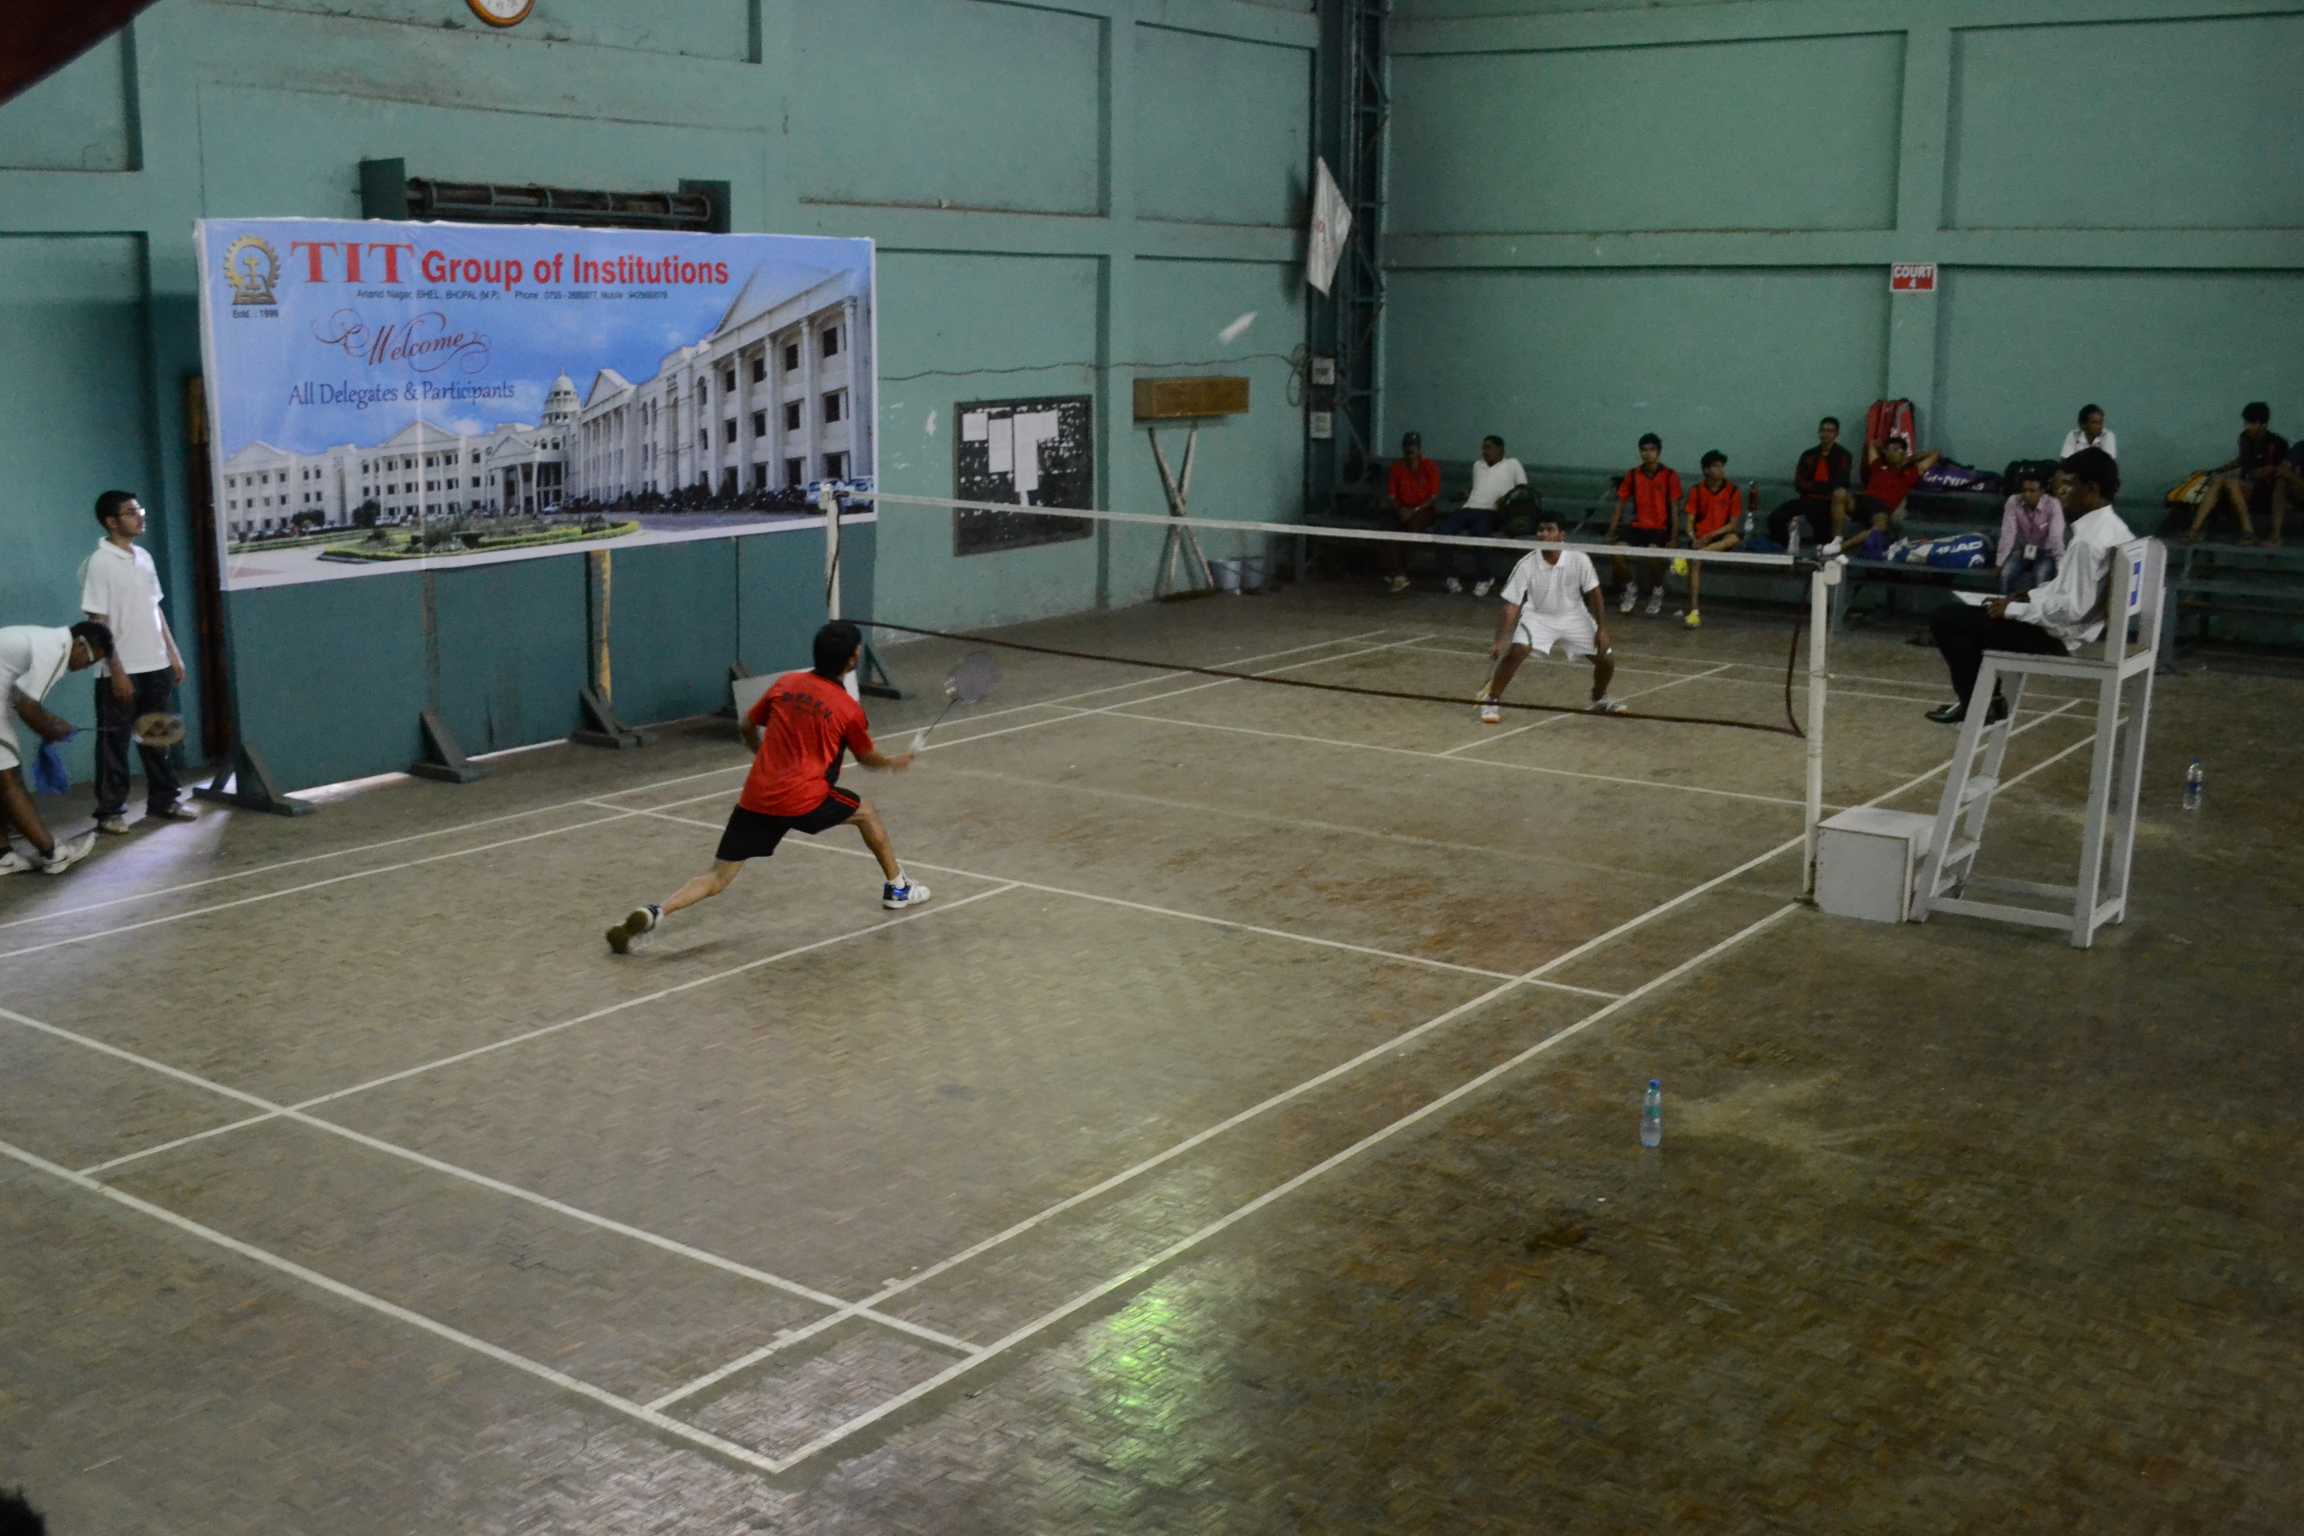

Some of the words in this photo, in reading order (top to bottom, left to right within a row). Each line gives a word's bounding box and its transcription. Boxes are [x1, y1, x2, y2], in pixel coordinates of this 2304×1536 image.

[290, 240, 415, 284] TIT
[421, 250, 523, 292] Group
[533, 253, 564, 285] of
[573, 253, 730, 285] Institutions
[1894, 265, 1933, 279] COURT
[314, 308, 491, 374] Welcome
[288, 381, 314, 406] All
[319, 380, 399, 410] Delegates
[404, 381, 417, 401] &
[422, 379, 515, 405] Participants
